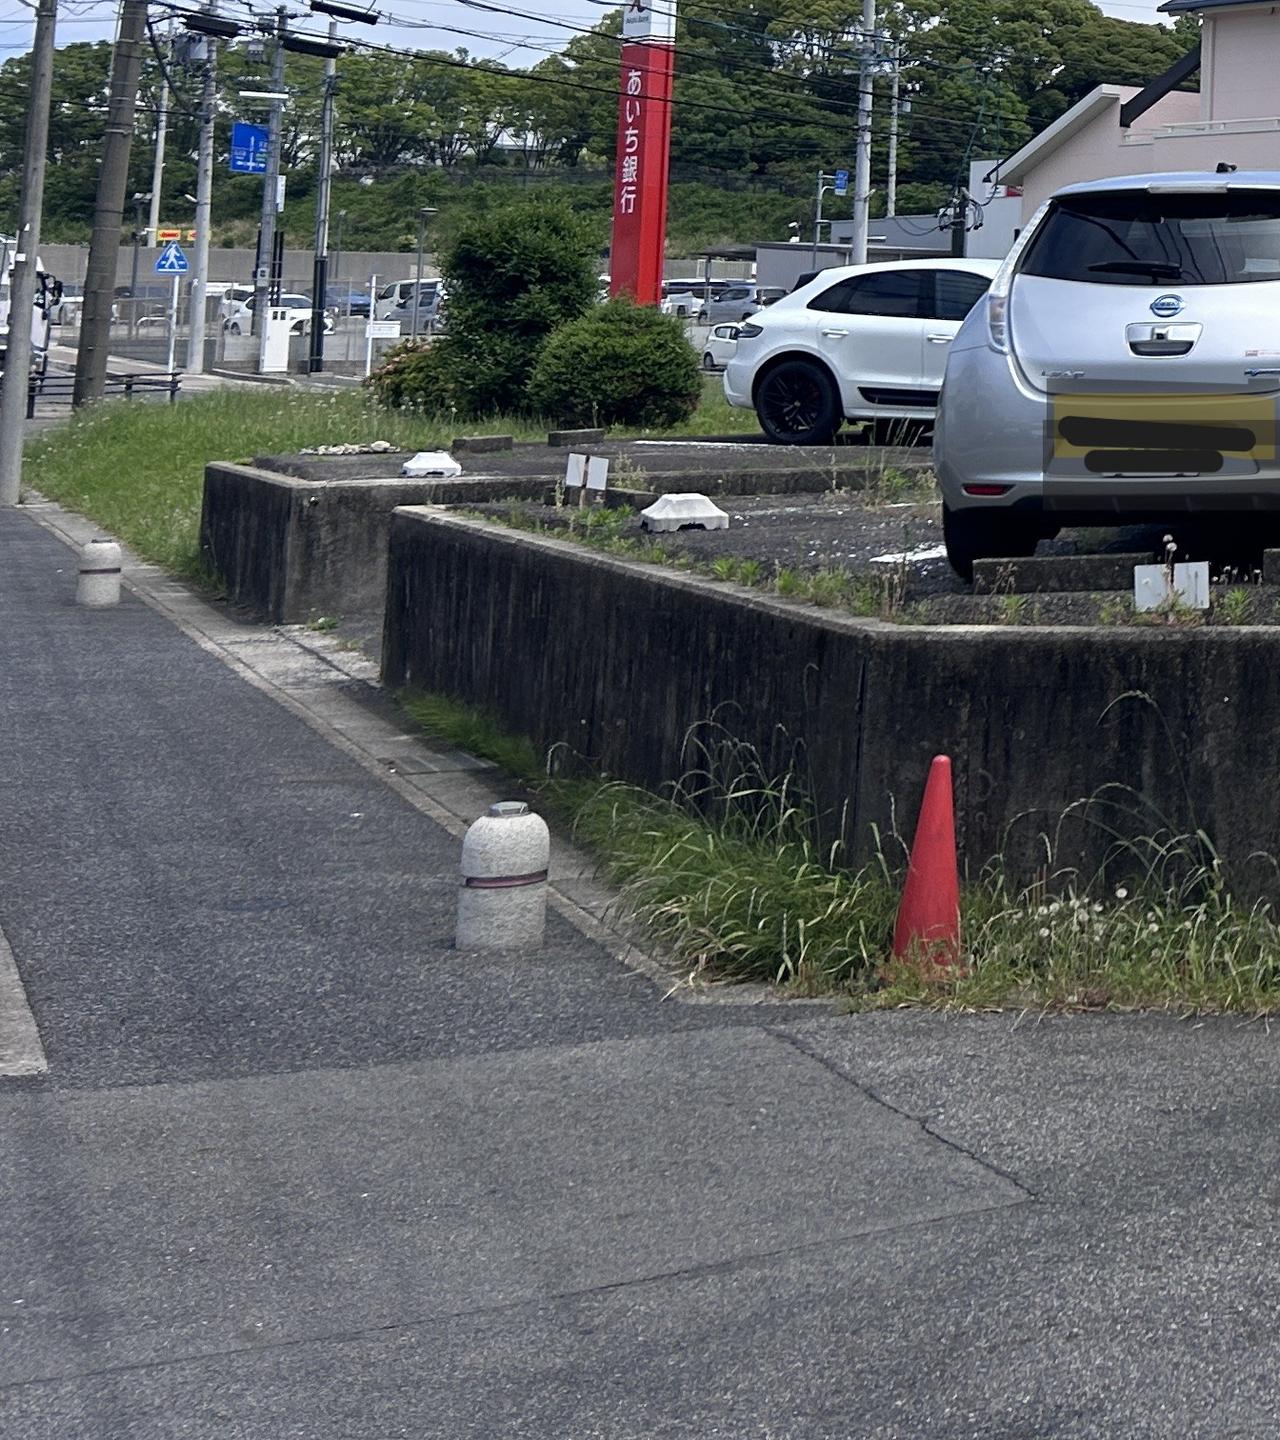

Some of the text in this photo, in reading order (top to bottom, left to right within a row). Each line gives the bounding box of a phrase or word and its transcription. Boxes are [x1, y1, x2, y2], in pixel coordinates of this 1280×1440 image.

[620, 69, 642, 214] あいち銀行
